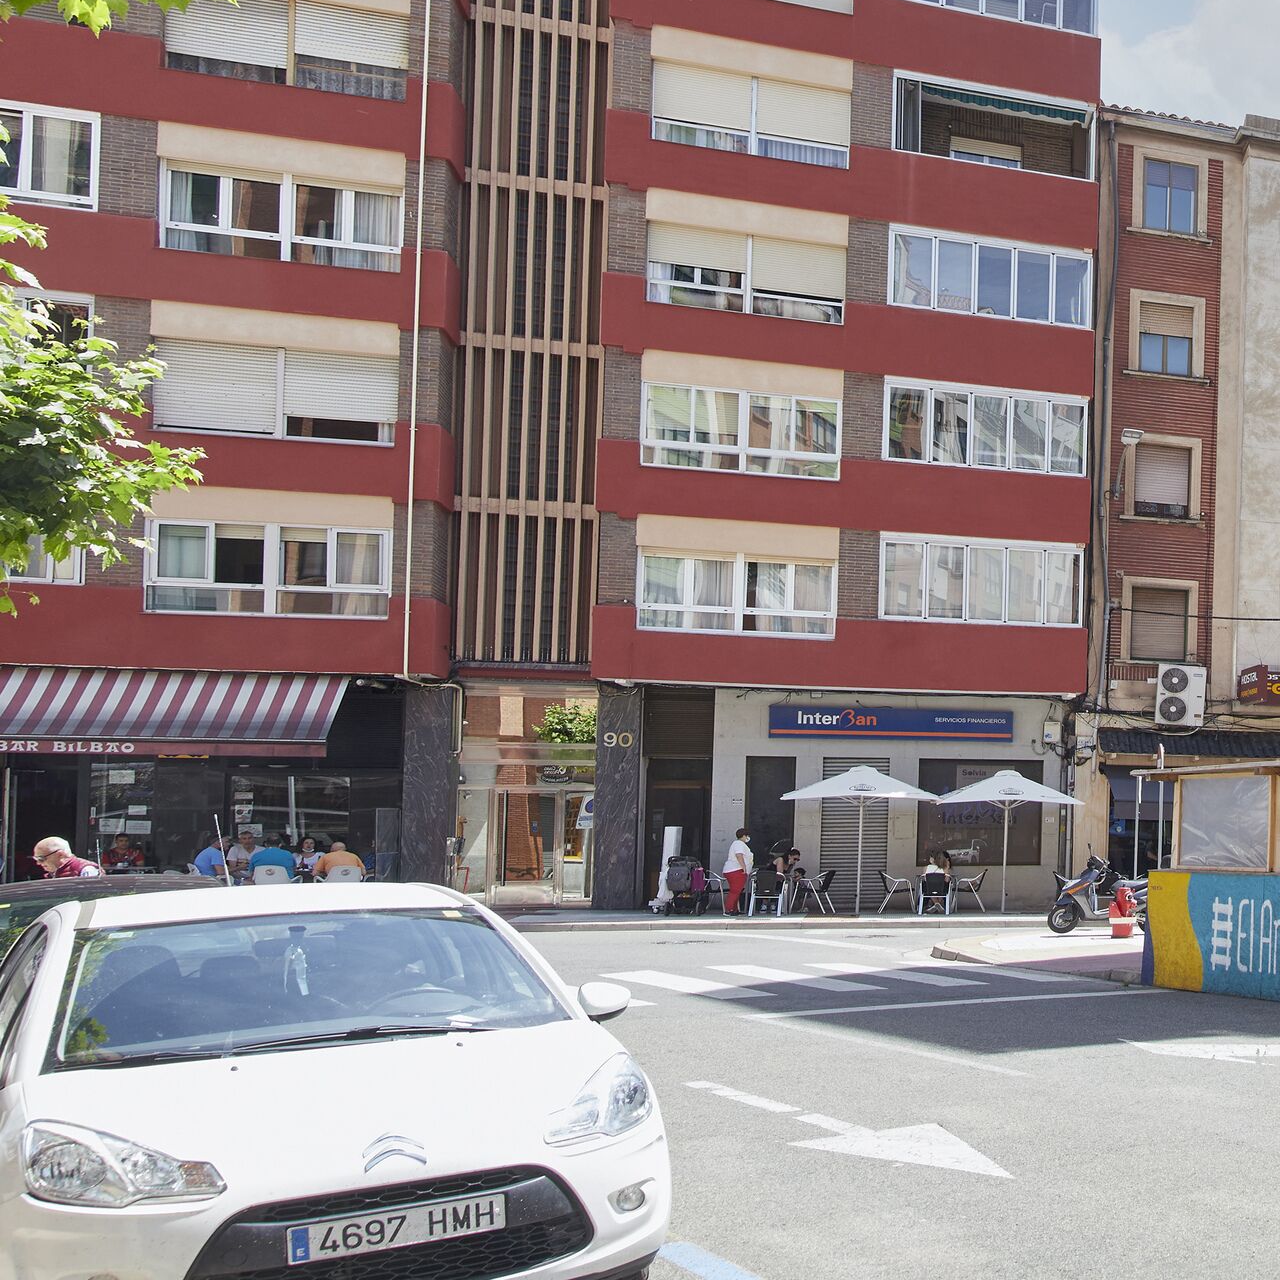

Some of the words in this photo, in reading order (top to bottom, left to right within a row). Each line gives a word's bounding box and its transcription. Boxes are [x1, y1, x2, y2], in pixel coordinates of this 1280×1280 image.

[603, 732, 633, 747] 90
[1236, 898, 1254, 973] El
[296, 1248, 305, 1256] E
[319, 1215, 407, 1253] 4697
[428, 1200, 495, 1236] HMH
